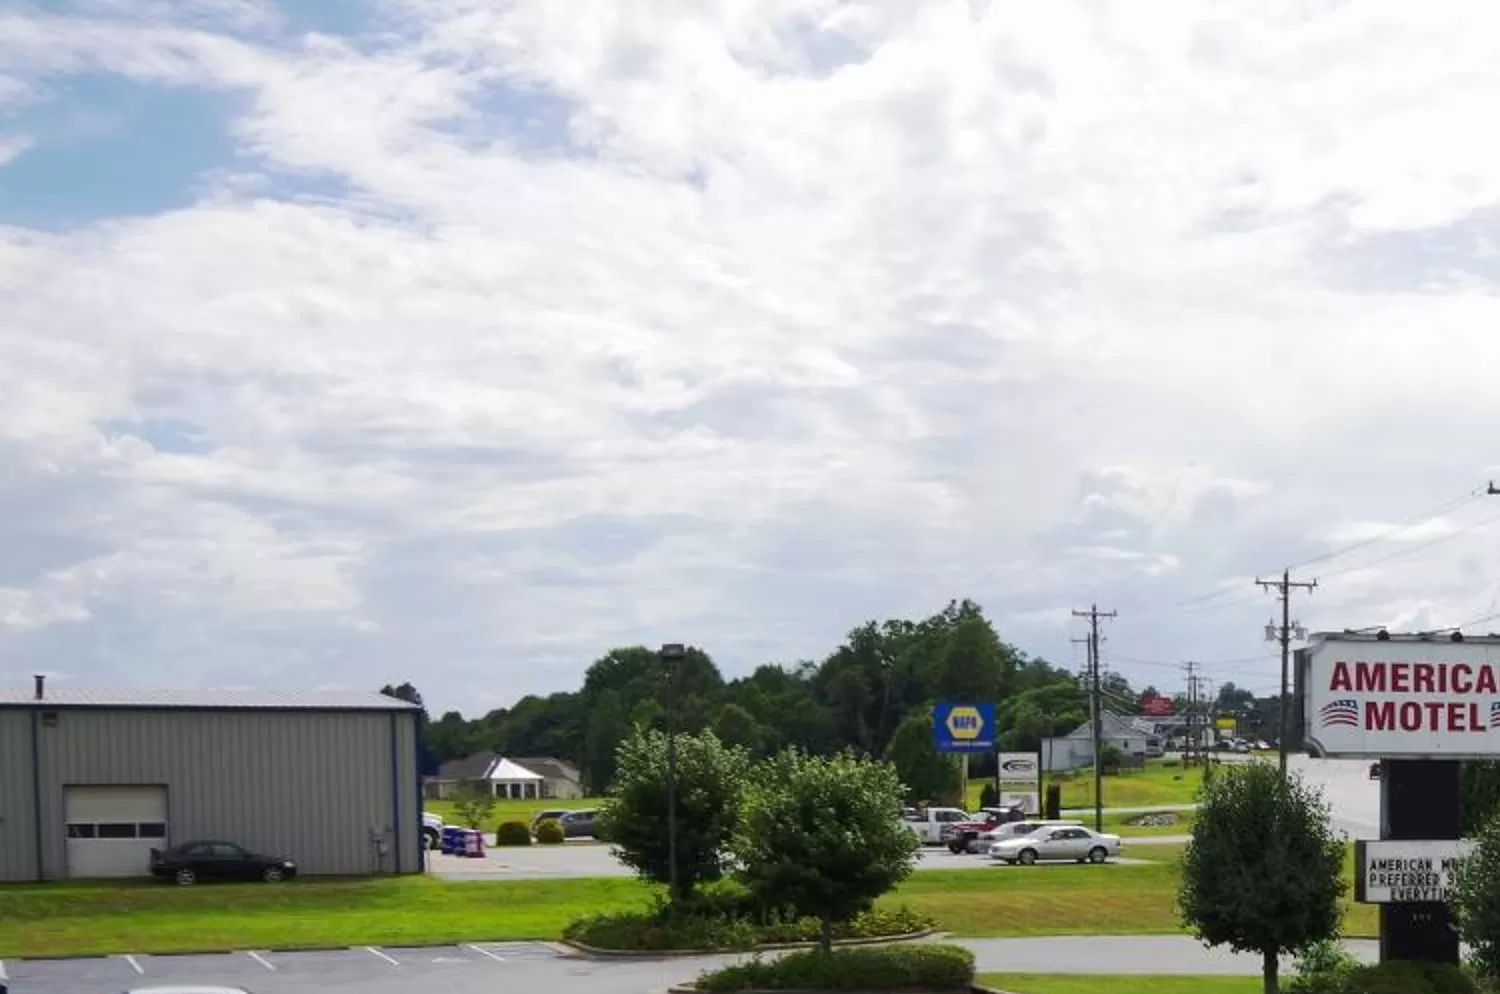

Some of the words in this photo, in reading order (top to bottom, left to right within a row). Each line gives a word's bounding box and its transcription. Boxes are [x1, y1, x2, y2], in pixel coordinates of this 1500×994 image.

[1365, 701, 1487, 732] MOTEL
[1369, 858, 1433, 871] AMERICAN
[1369, 872, 1440, 888] PREFERRED
